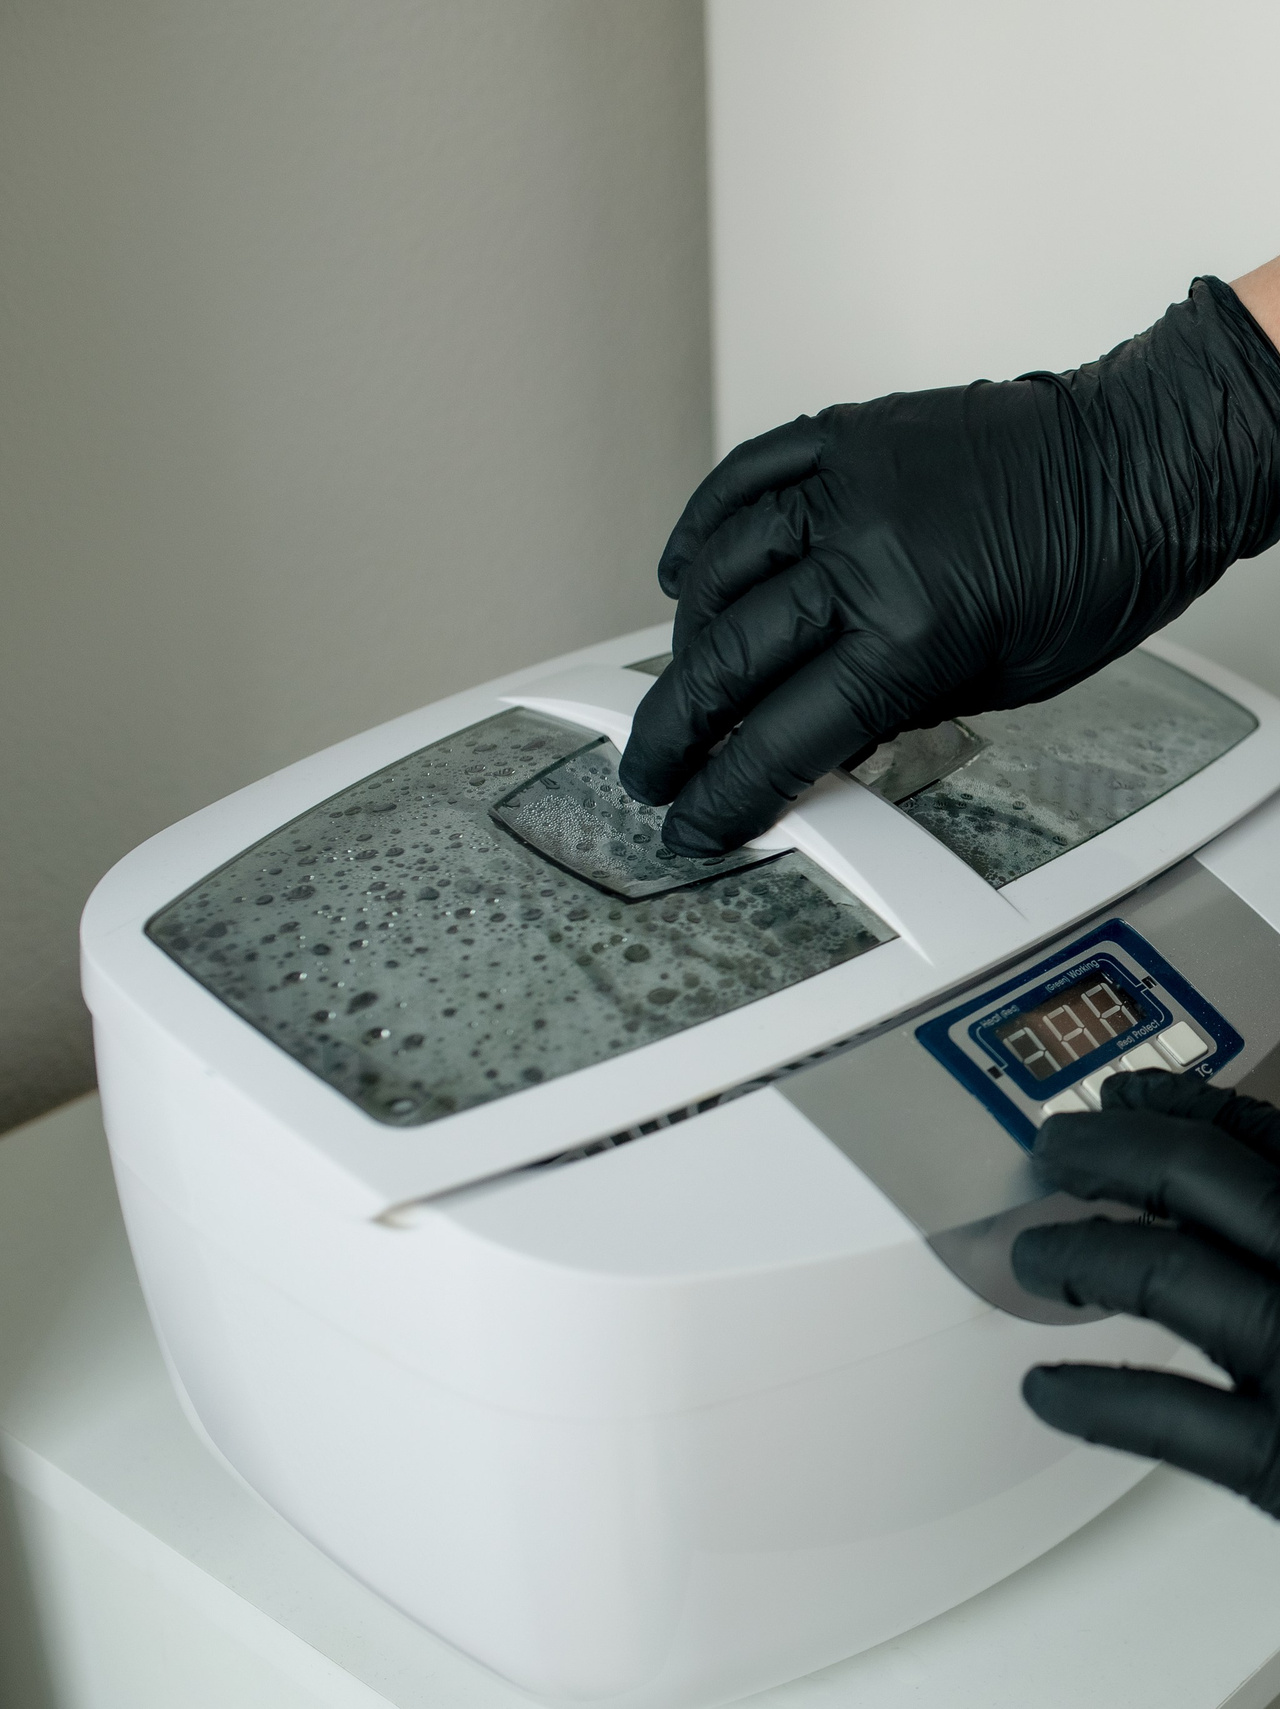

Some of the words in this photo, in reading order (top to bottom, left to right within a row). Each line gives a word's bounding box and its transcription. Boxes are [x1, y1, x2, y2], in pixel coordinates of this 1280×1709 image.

[1045, 975, 1071, 993] (Green)
[1066, 960, 1100, 979] Working
[1116, 1035, 1136, 1050] (Red)
[1132, 1019, 1160, 1039] Protect
